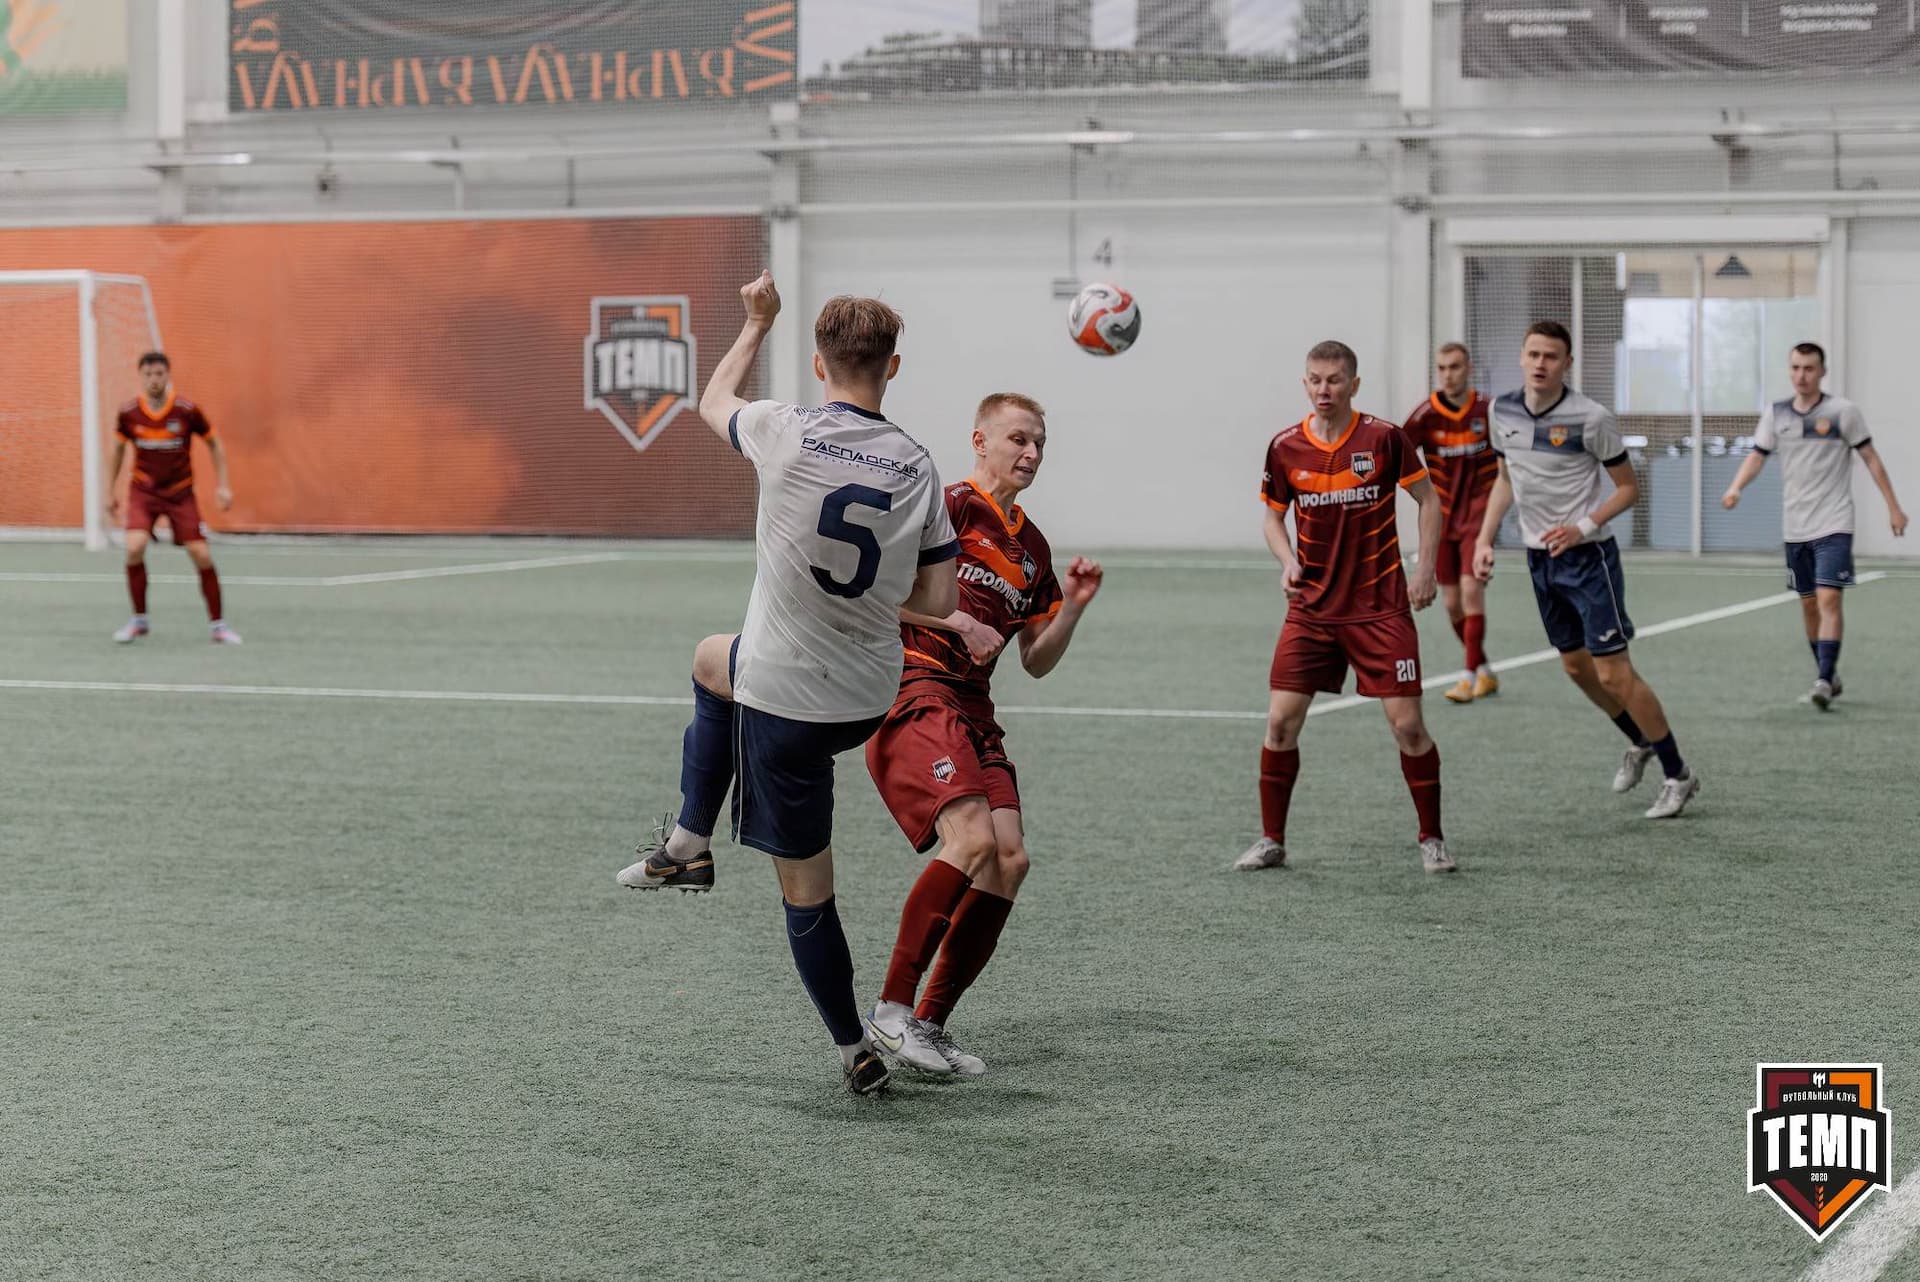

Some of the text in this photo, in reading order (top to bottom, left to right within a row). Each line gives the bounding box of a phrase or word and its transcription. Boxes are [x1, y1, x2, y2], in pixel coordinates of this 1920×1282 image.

[1093, 237, 1112, 269] 4
[595, 338, 686, 393] ТЕМП
[809, 483, 892, 599] 5
[1395, 658, 1416, 682] 20
